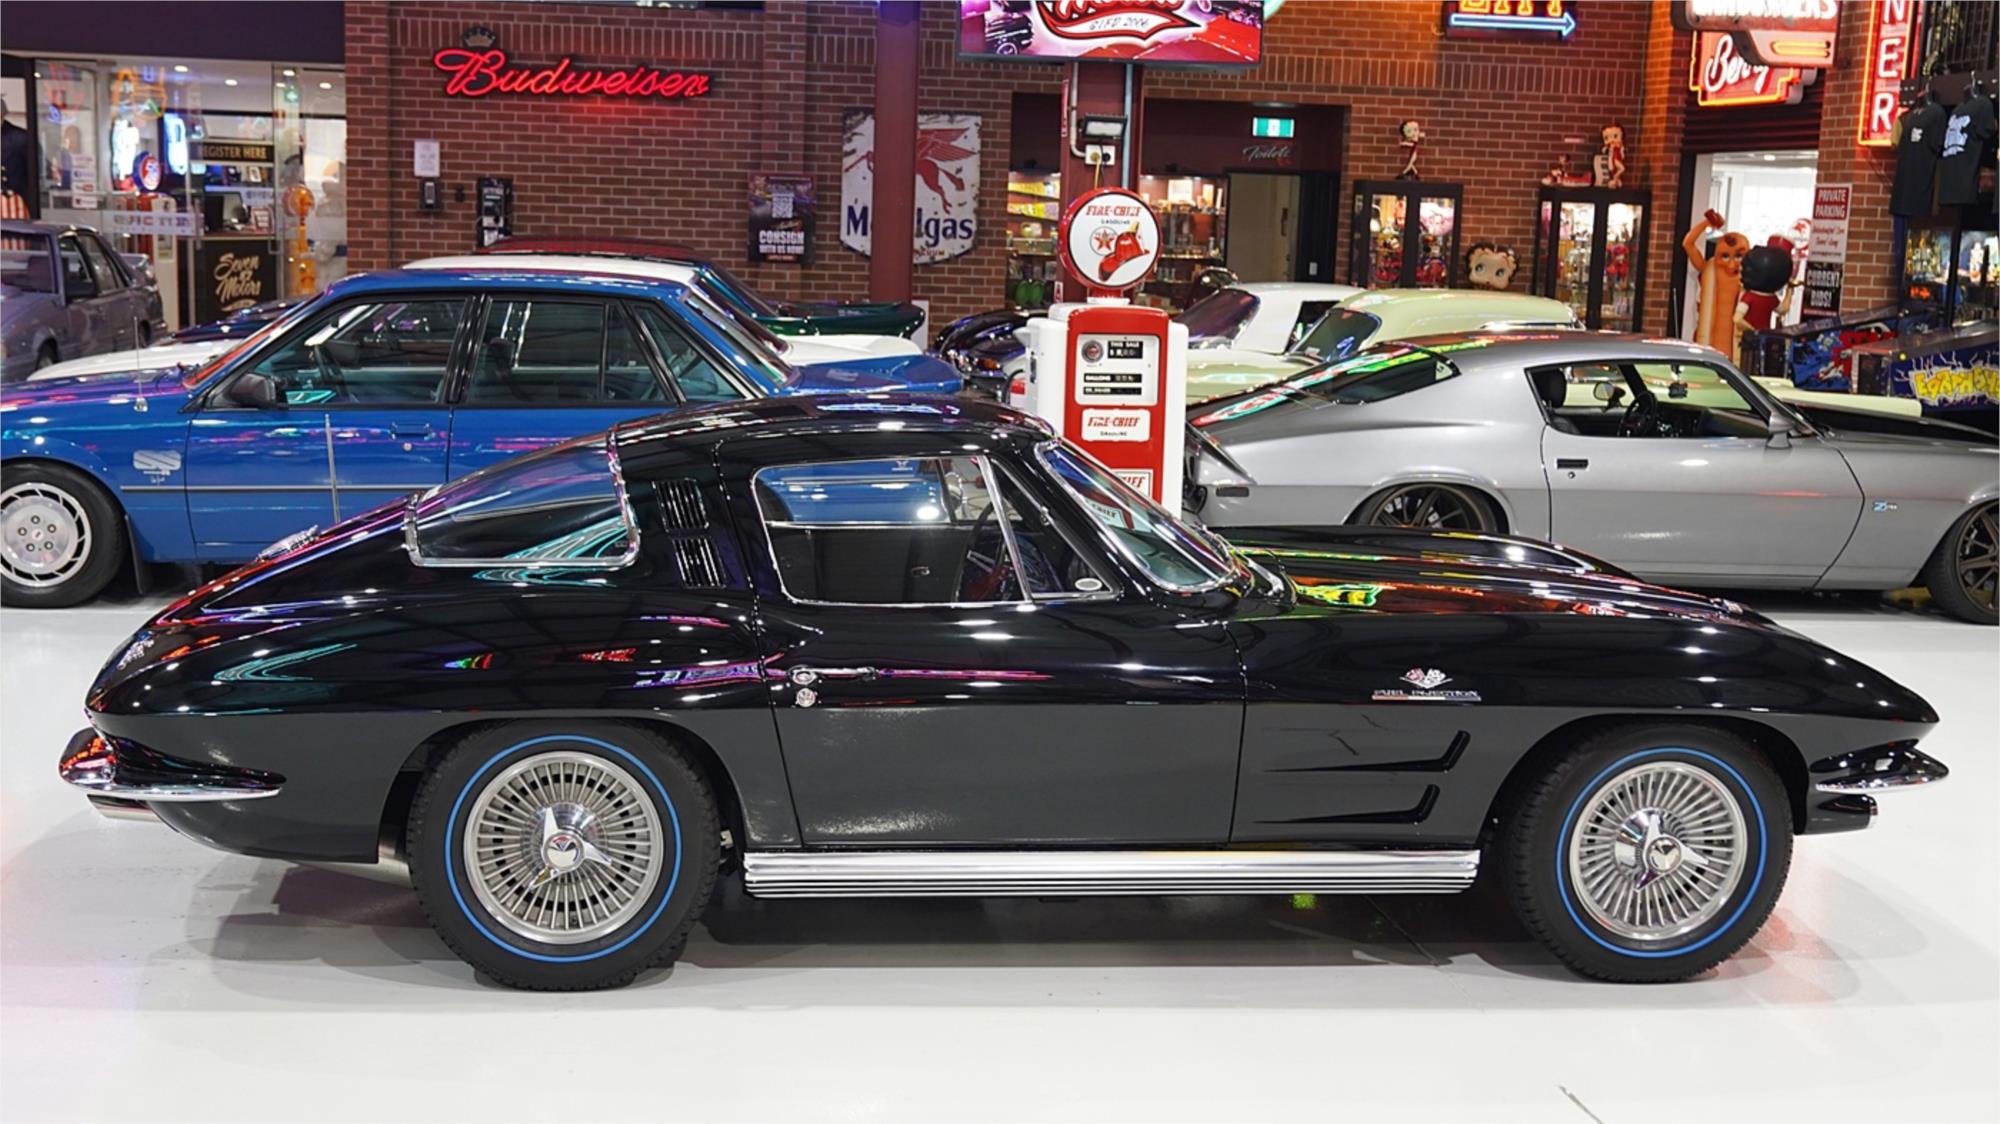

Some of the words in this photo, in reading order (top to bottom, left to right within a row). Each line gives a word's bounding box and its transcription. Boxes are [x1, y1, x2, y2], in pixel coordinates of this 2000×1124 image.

[434, 49, 710, 97] Budweiser
[242, 146, 267, 159] HERE
[1818, 189, 1847, 202] PRIVATE
[1815, 203, 1846, 218] PARKING
[846, 204, 974, 248] Mlgas
[759, 229, 805, 245] CONSIGN
[1806, 270, 1840, 288] CURRENT
